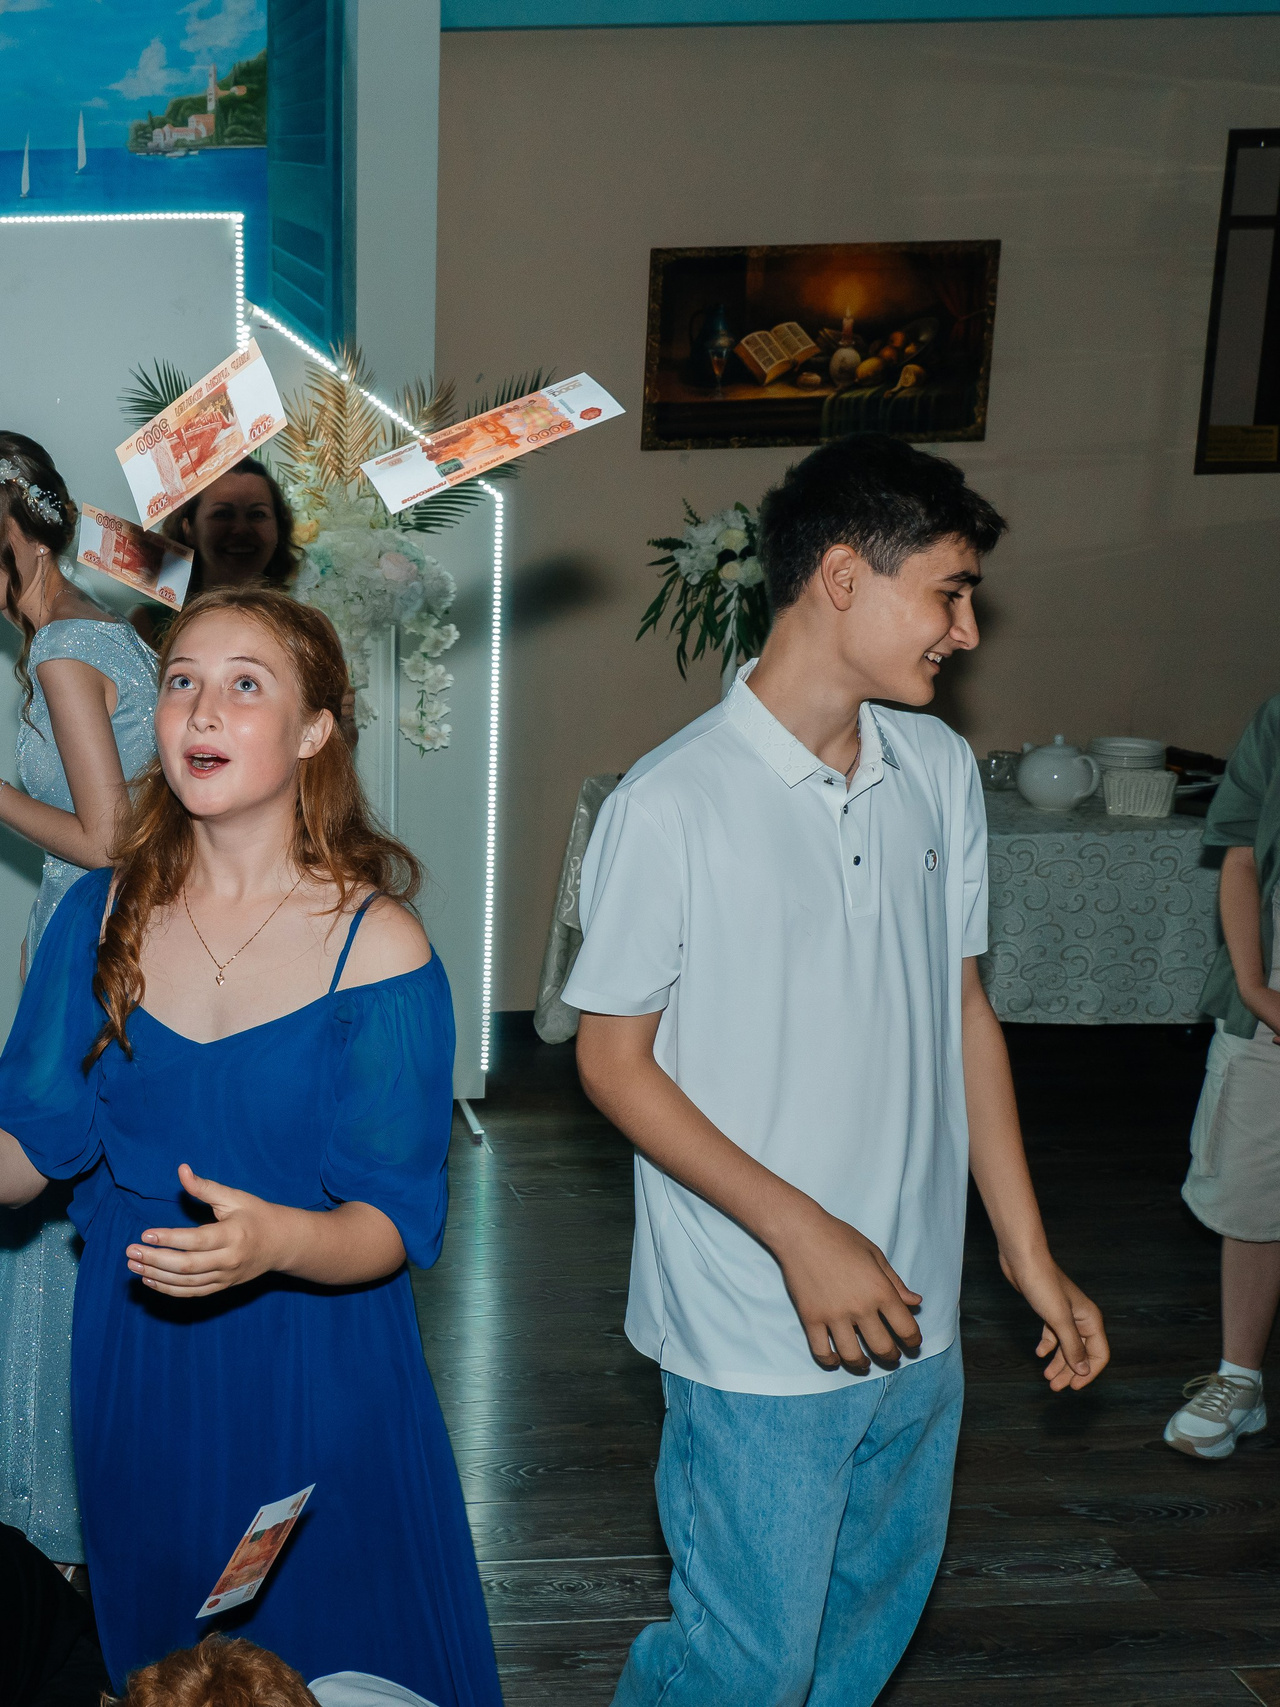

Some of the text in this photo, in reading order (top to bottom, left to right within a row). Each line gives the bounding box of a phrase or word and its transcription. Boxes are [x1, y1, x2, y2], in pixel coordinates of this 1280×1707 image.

[135, 417, 171, 456] 5000
[249, 416, 272, 440] 5000
[526, 420, 574, 444] 5000
[448, 466, 477, 483] БАНКА
[401, 479, 447, 505] ПРИКОЛОВ
[148, 494, 169, 516] 5000
[94, 512, 123, 533] 5000
[158, 588, 175, 601] 5000
